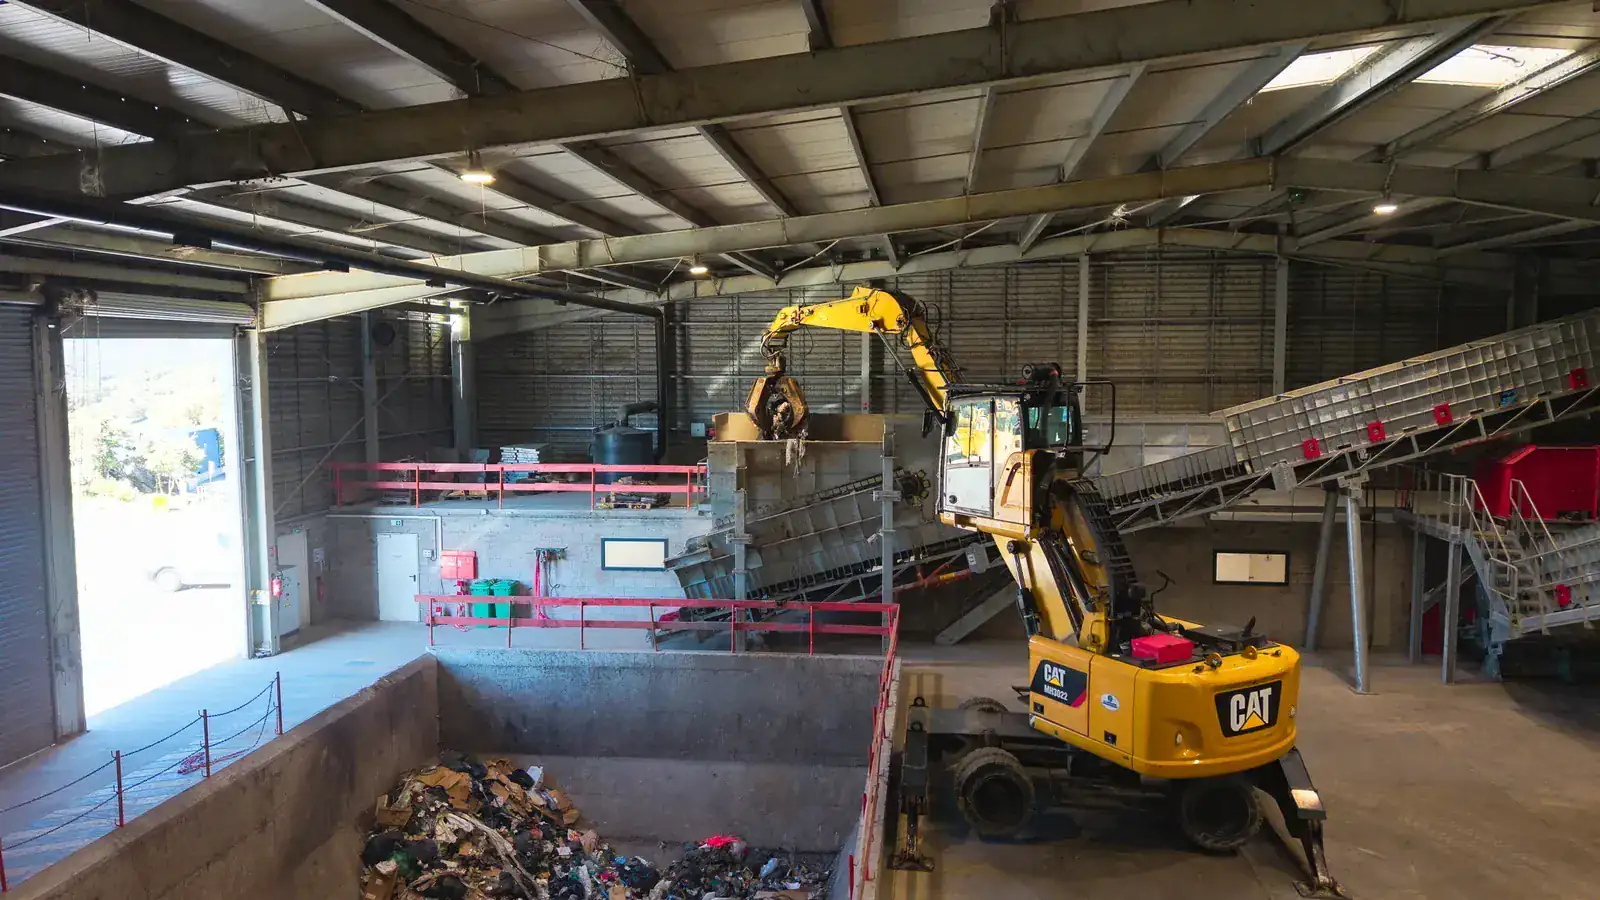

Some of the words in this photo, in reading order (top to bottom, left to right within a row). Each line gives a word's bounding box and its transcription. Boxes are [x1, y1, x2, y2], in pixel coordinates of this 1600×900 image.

[1044, 663, 1066, 687] CAT
[1043, 684, 1069, 701] MH3022
[1230, 687, 1272, 732] CAT
